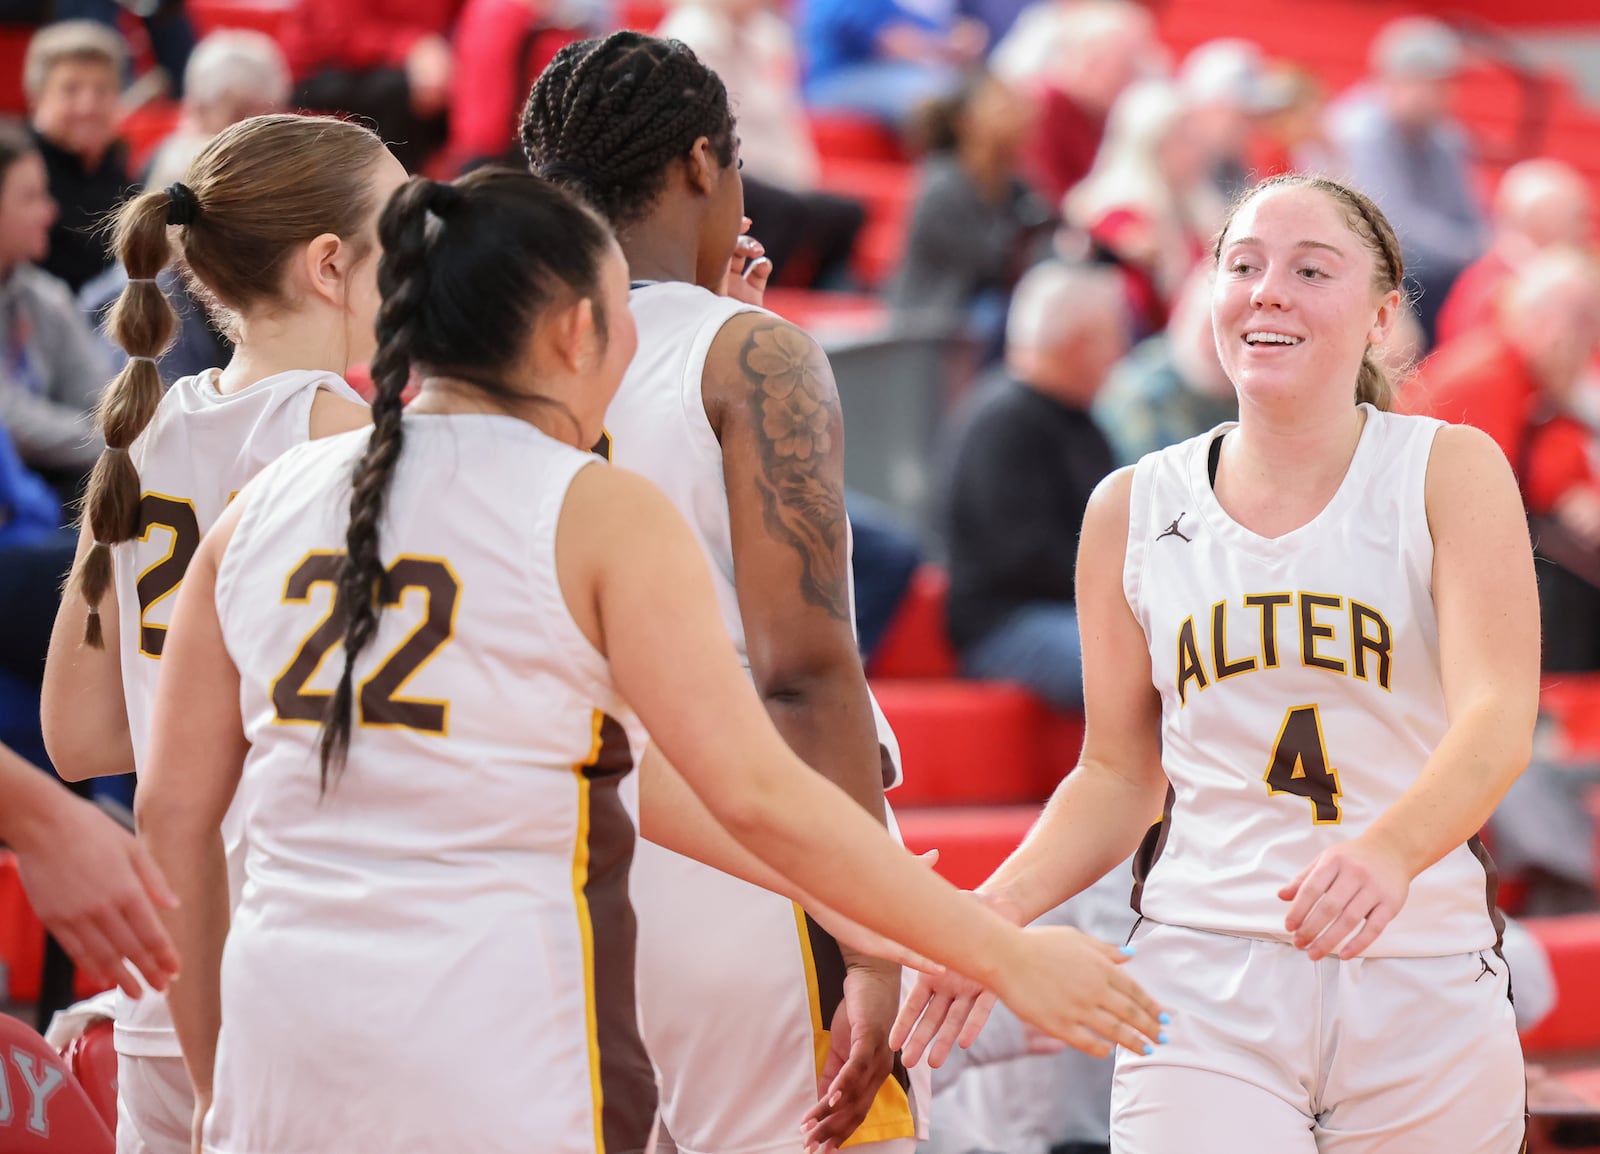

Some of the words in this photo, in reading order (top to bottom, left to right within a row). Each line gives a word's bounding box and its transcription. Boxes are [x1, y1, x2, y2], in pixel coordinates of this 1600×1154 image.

[136, 490, 240, 660] 2
[269, 549, 463, 737] 22
[1176, 591, 1393, 709] ALTER
[1263, 703, 1343, 825] 4
